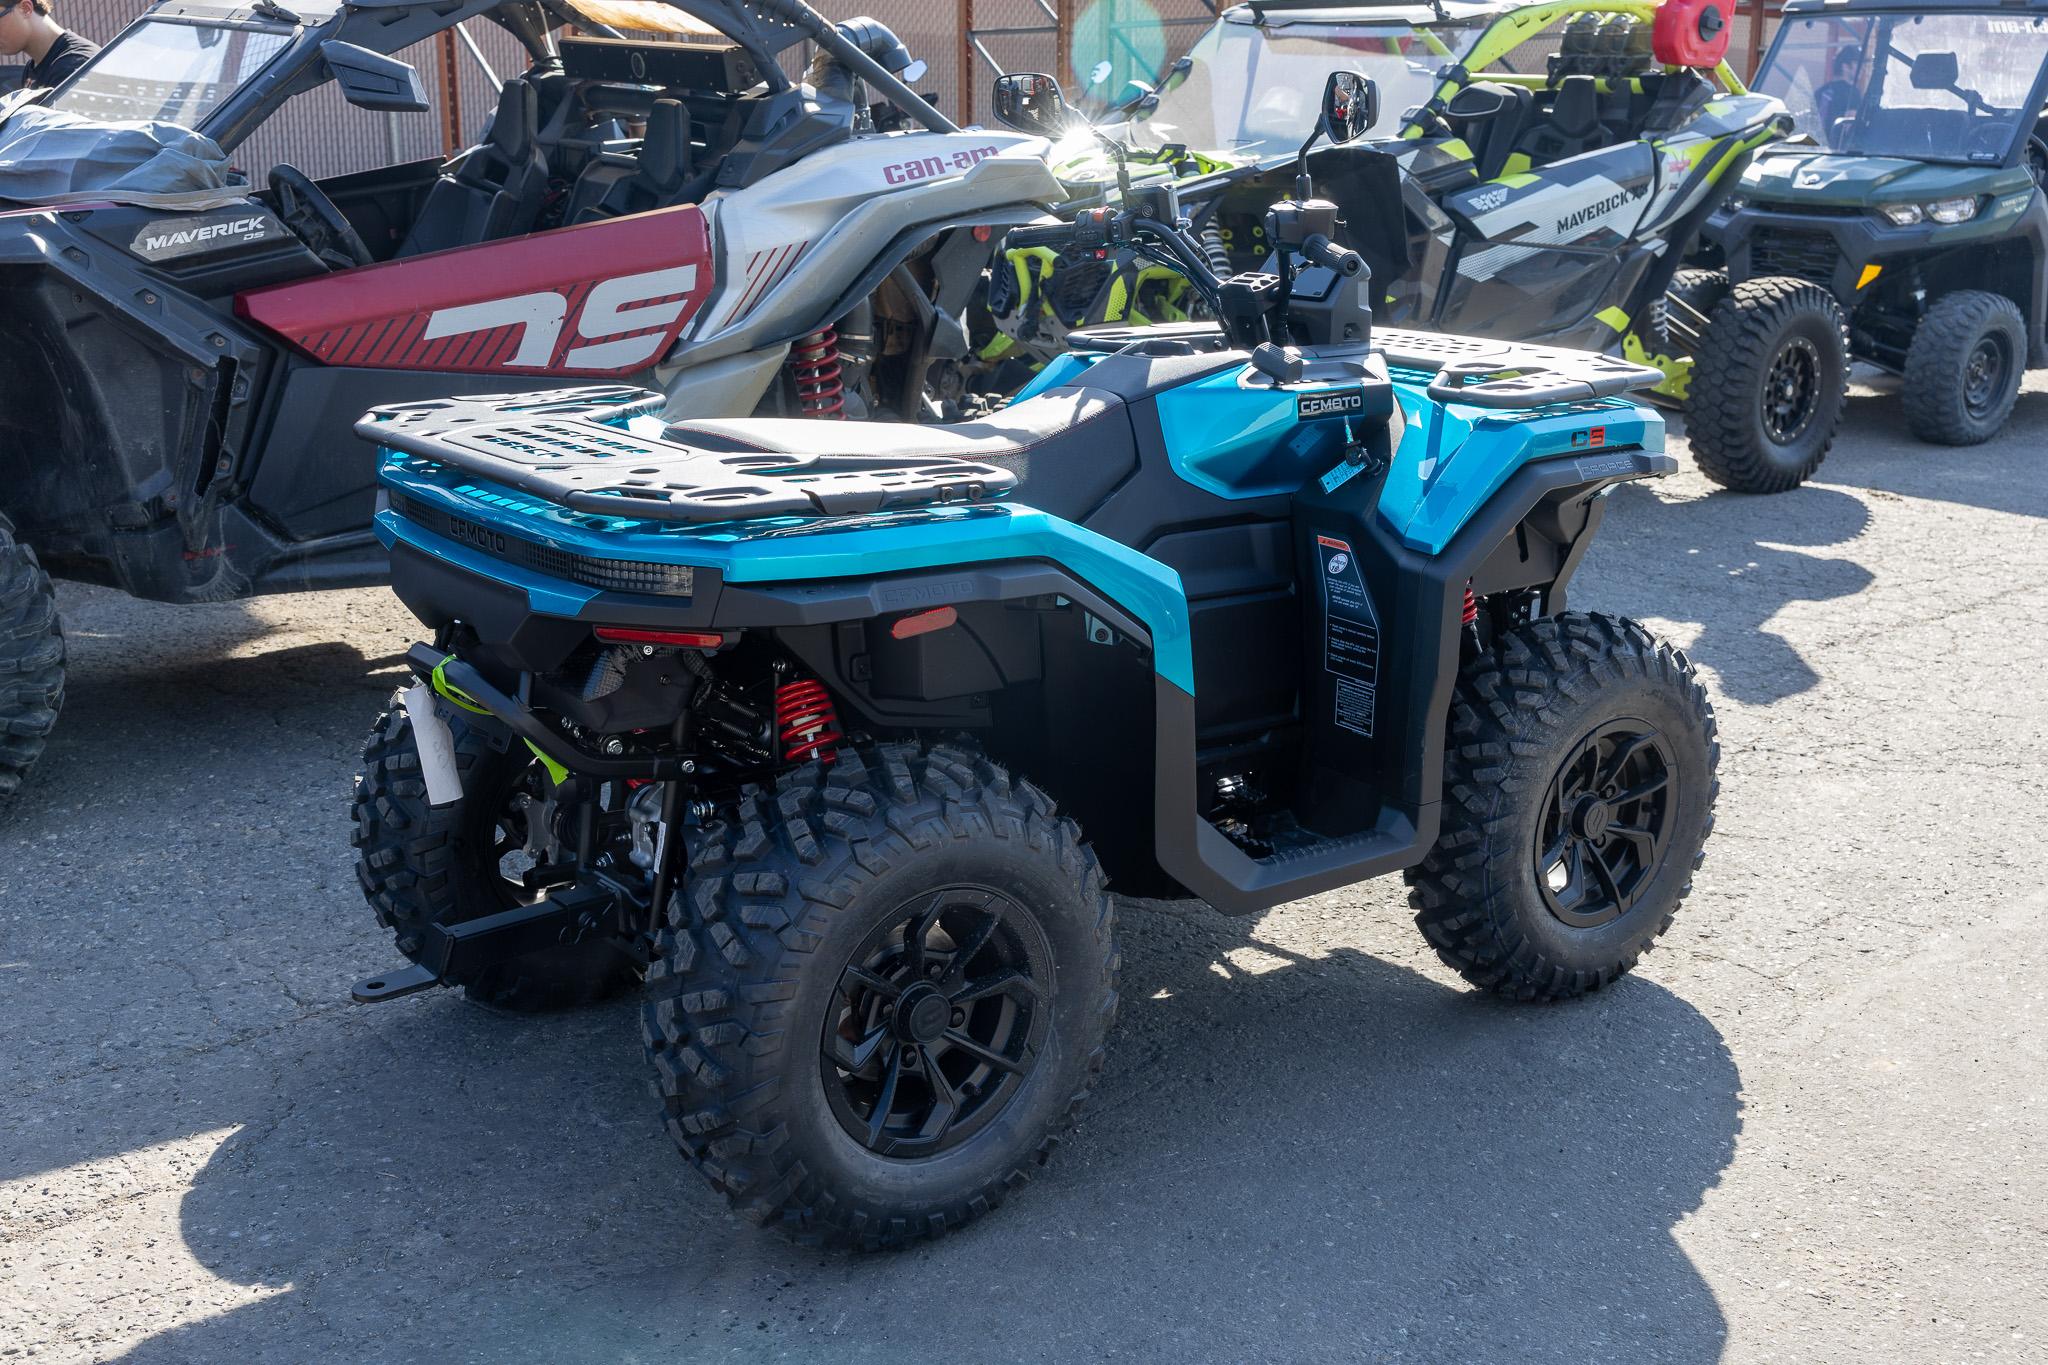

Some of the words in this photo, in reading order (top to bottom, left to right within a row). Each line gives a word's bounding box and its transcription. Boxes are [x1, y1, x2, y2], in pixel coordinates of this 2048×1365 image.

[883, 146, 998, 184] can-am
[1556, 189, 1630, 234] MAVERICK
[145, 216, 265, 251] MAVERICK
[243, 231, 264, 240] DS
[1301, 396, 1361, 413] CFMOTO
[449, 517, 505, 554] CFMOTO
